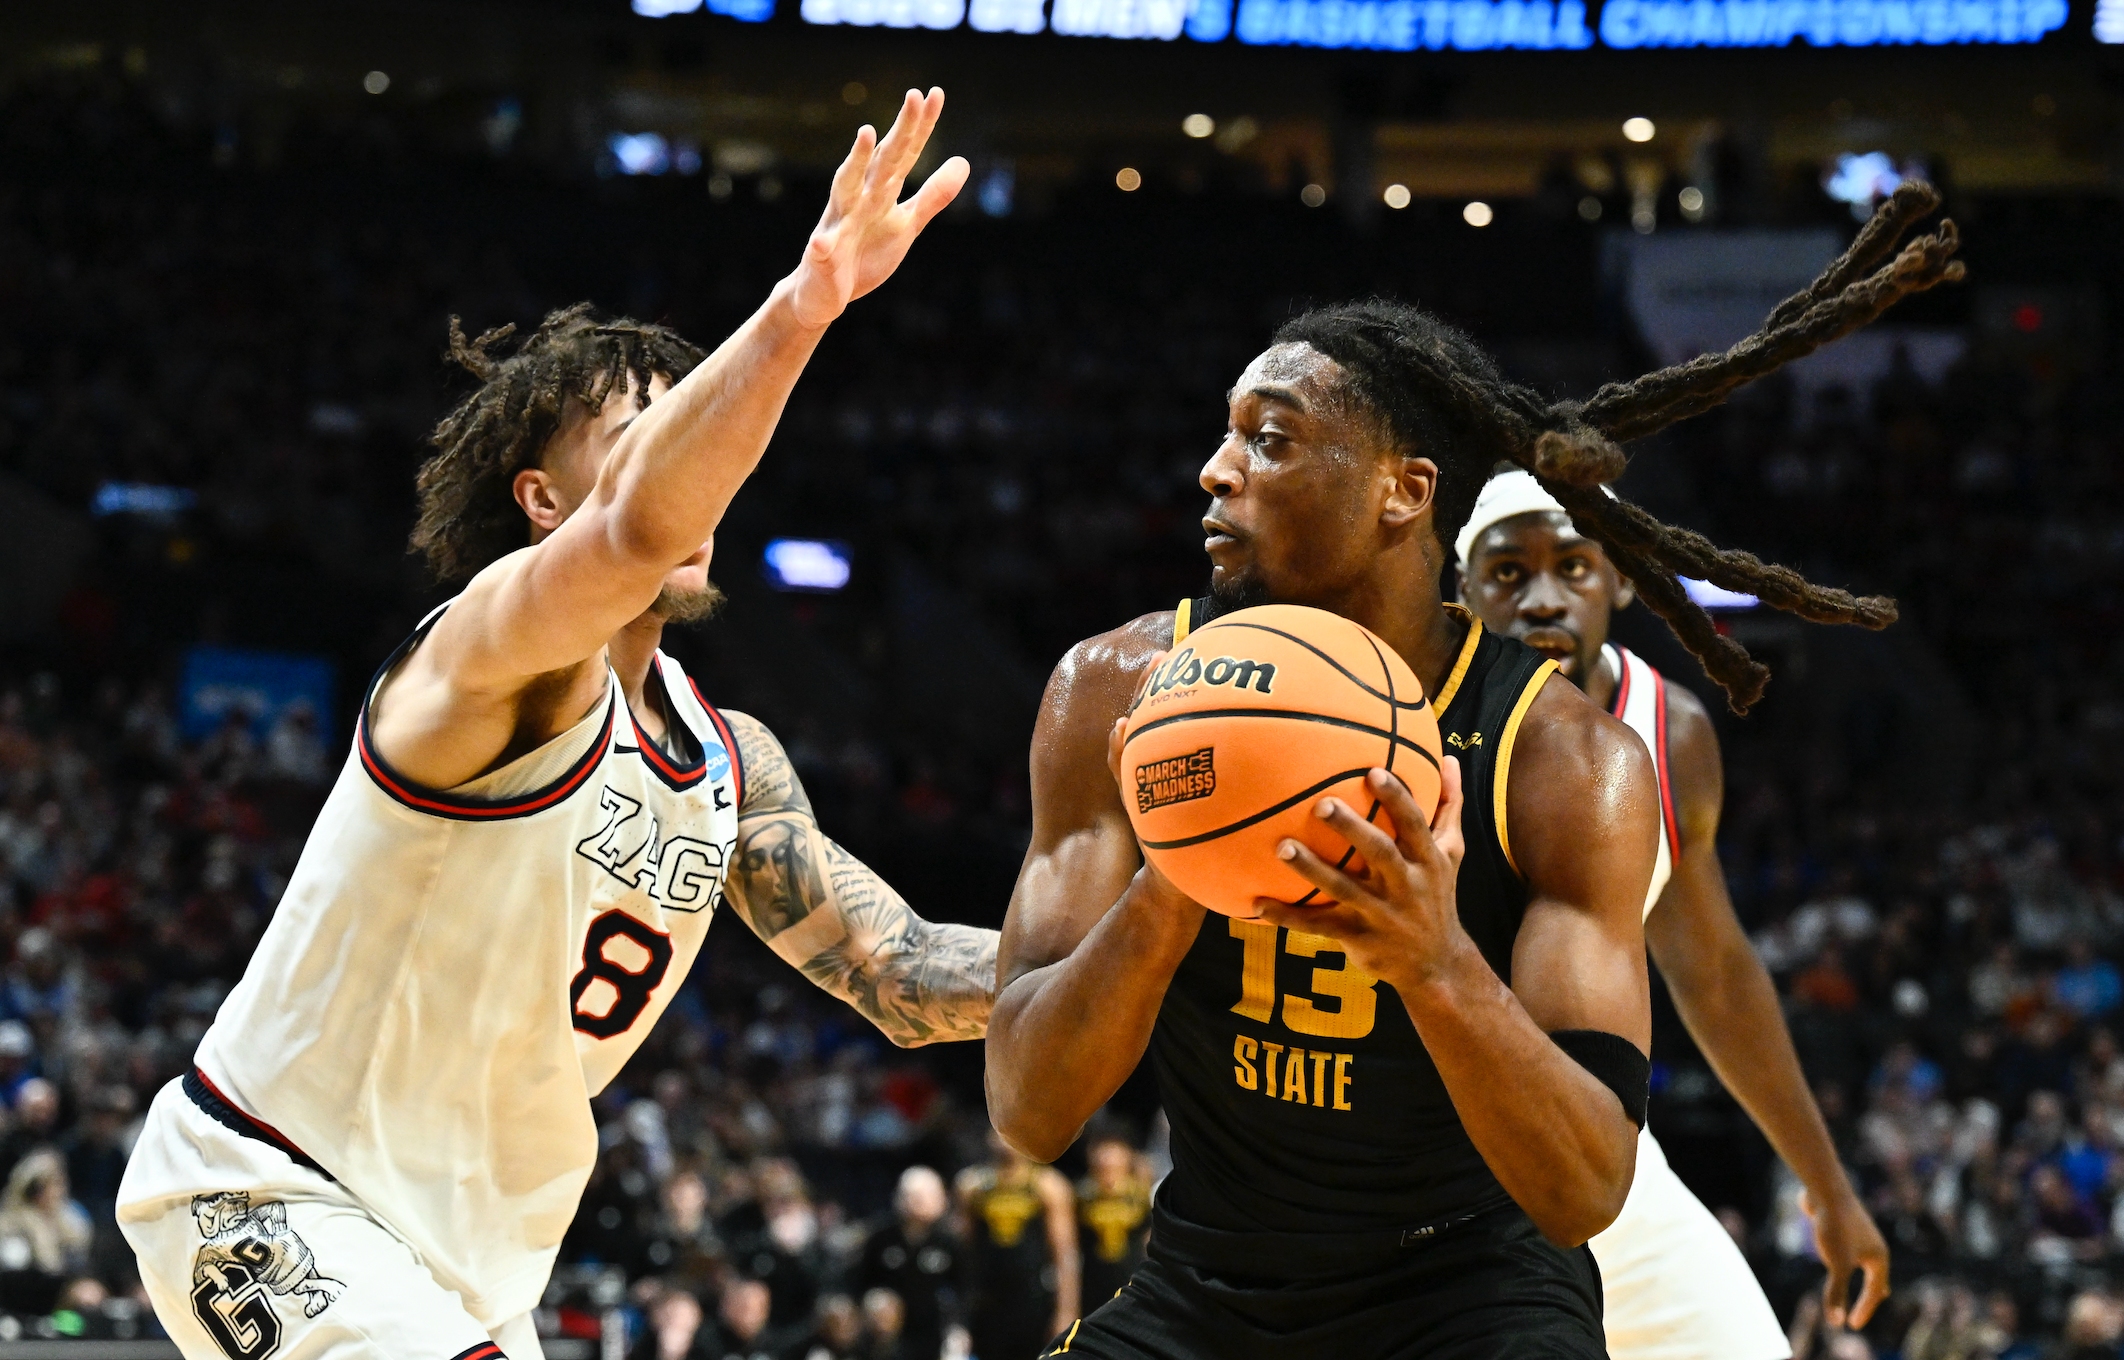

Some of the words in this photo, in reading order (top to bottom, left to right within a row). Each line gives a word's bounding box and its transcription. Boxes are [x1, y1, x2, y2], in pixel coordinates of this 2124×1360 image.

[1235, 0, 1593, 49] BASKETBALL
[1601, 0, 2068, 47] CHAMPIONSHIP
[1150, 693, 1171, 706] EVO
[1173, 689, 1199, 699] NXT
[705, 752, 729, 771] CAA
[1145, 758, 1187, 784] MARCH
[1152, 771, 1214, 800] MADNESS
[569, 908, 673, 1041] 8
[1228, 917, 1379, 1040] 13
[1233, 1034, 1354, 1111] STATE
[231, 1236, 271, 1267] G
[190, 1260, 283, 1360] G
